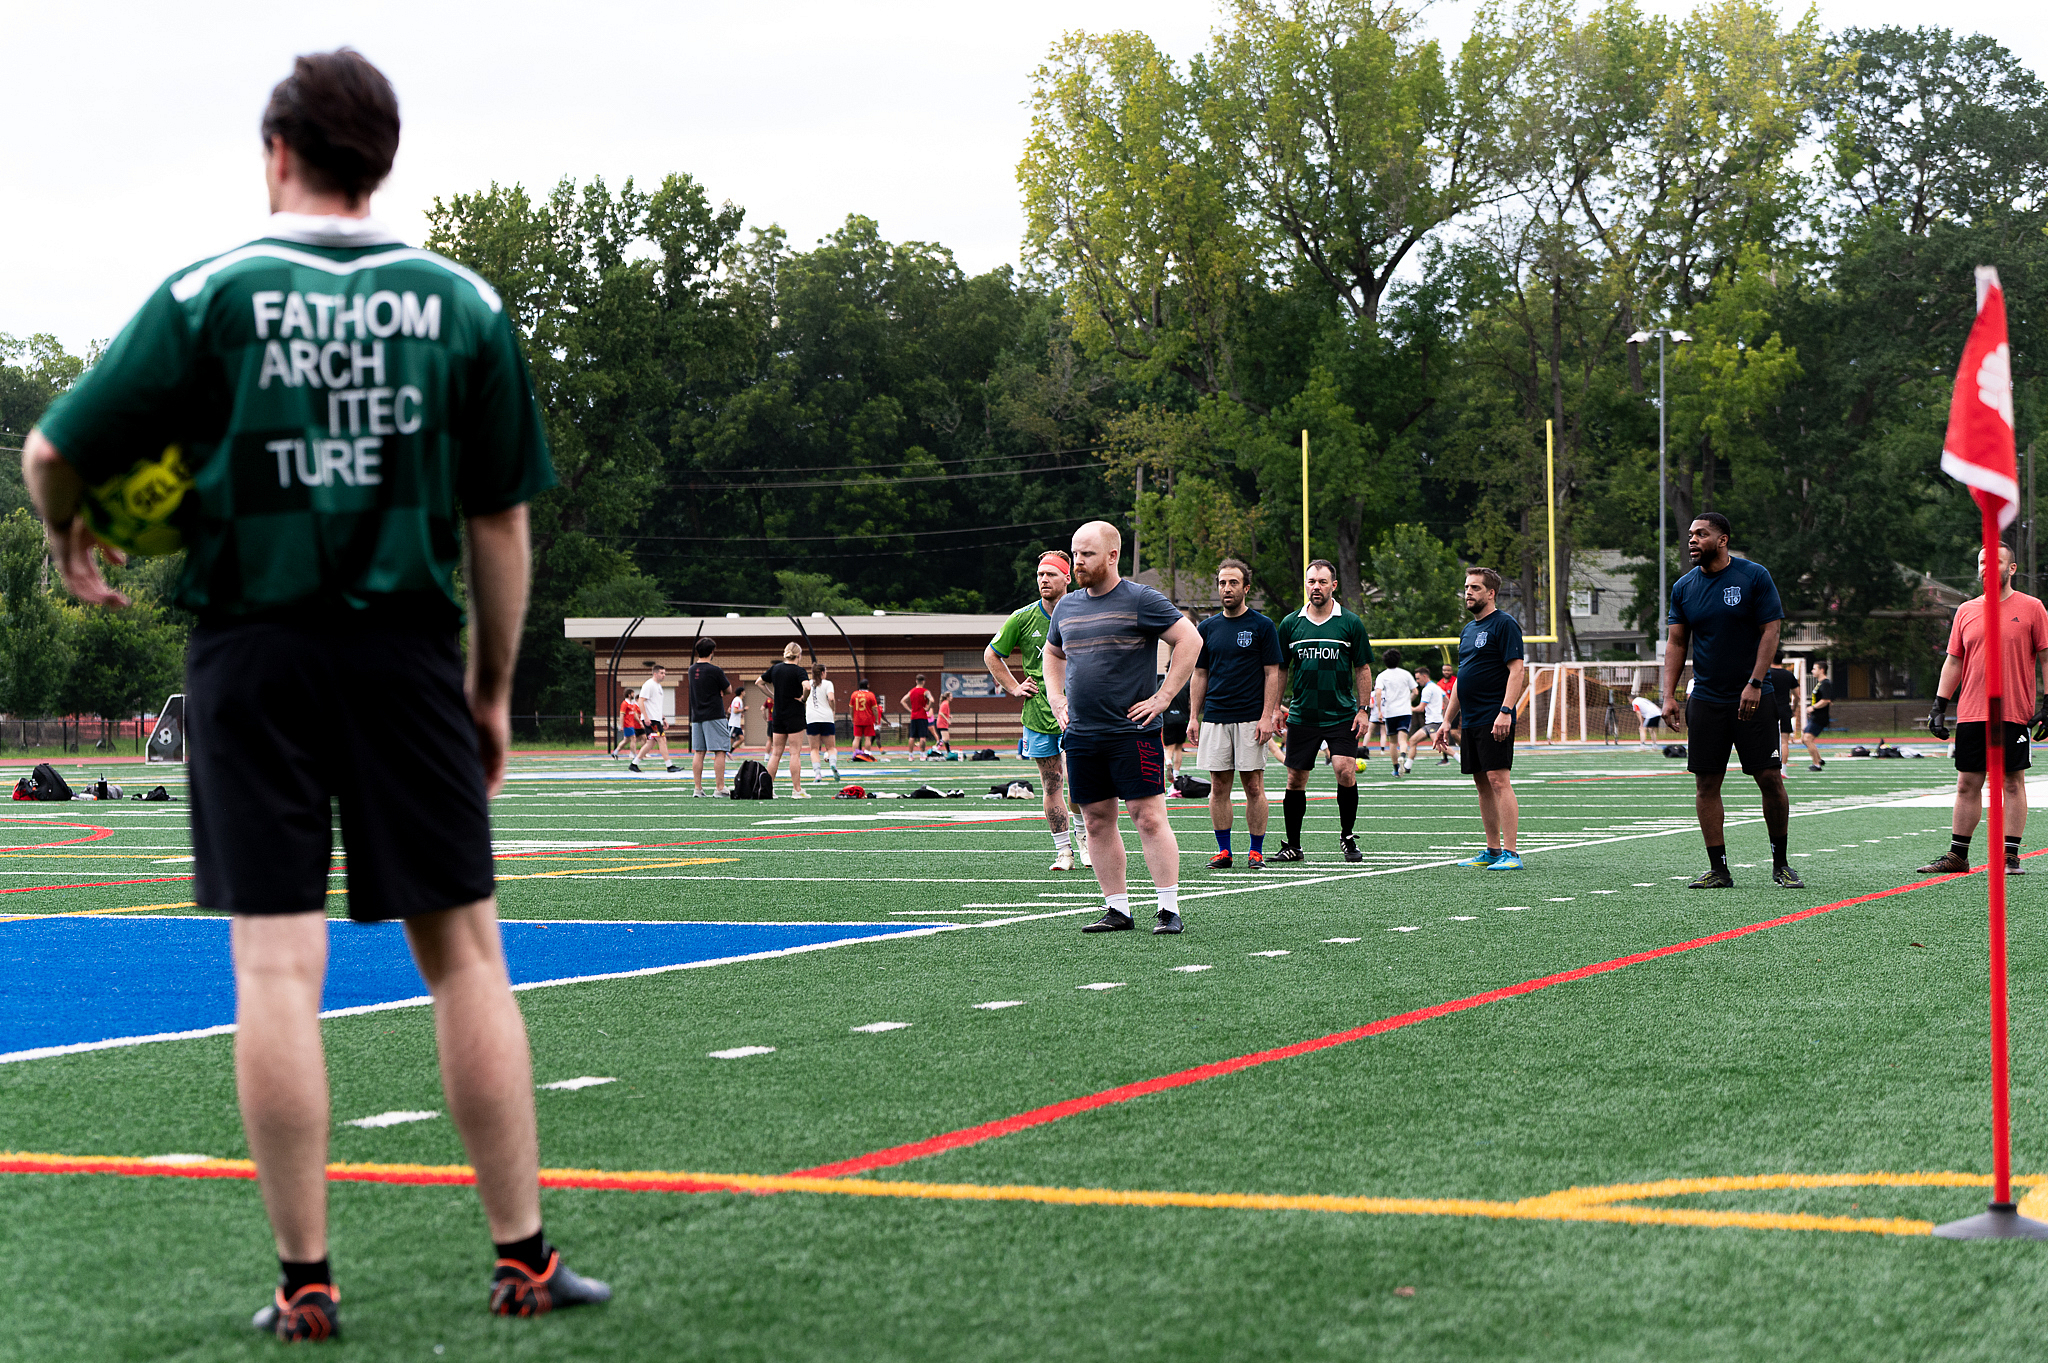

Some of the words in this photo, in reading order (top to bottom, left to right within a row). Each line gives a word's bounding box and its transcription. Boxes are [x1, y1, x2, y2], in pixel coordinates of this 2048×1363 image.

[252, 290, 441, 340] FATHOM
[258, 338, 386, 389] ARCH
[328, 384, 423, 438] ITEC
[265, 436, 384, 488] TURE
[1297, 647, 1340, 660] FATHOM
[855, 697, 867, 711] 13
